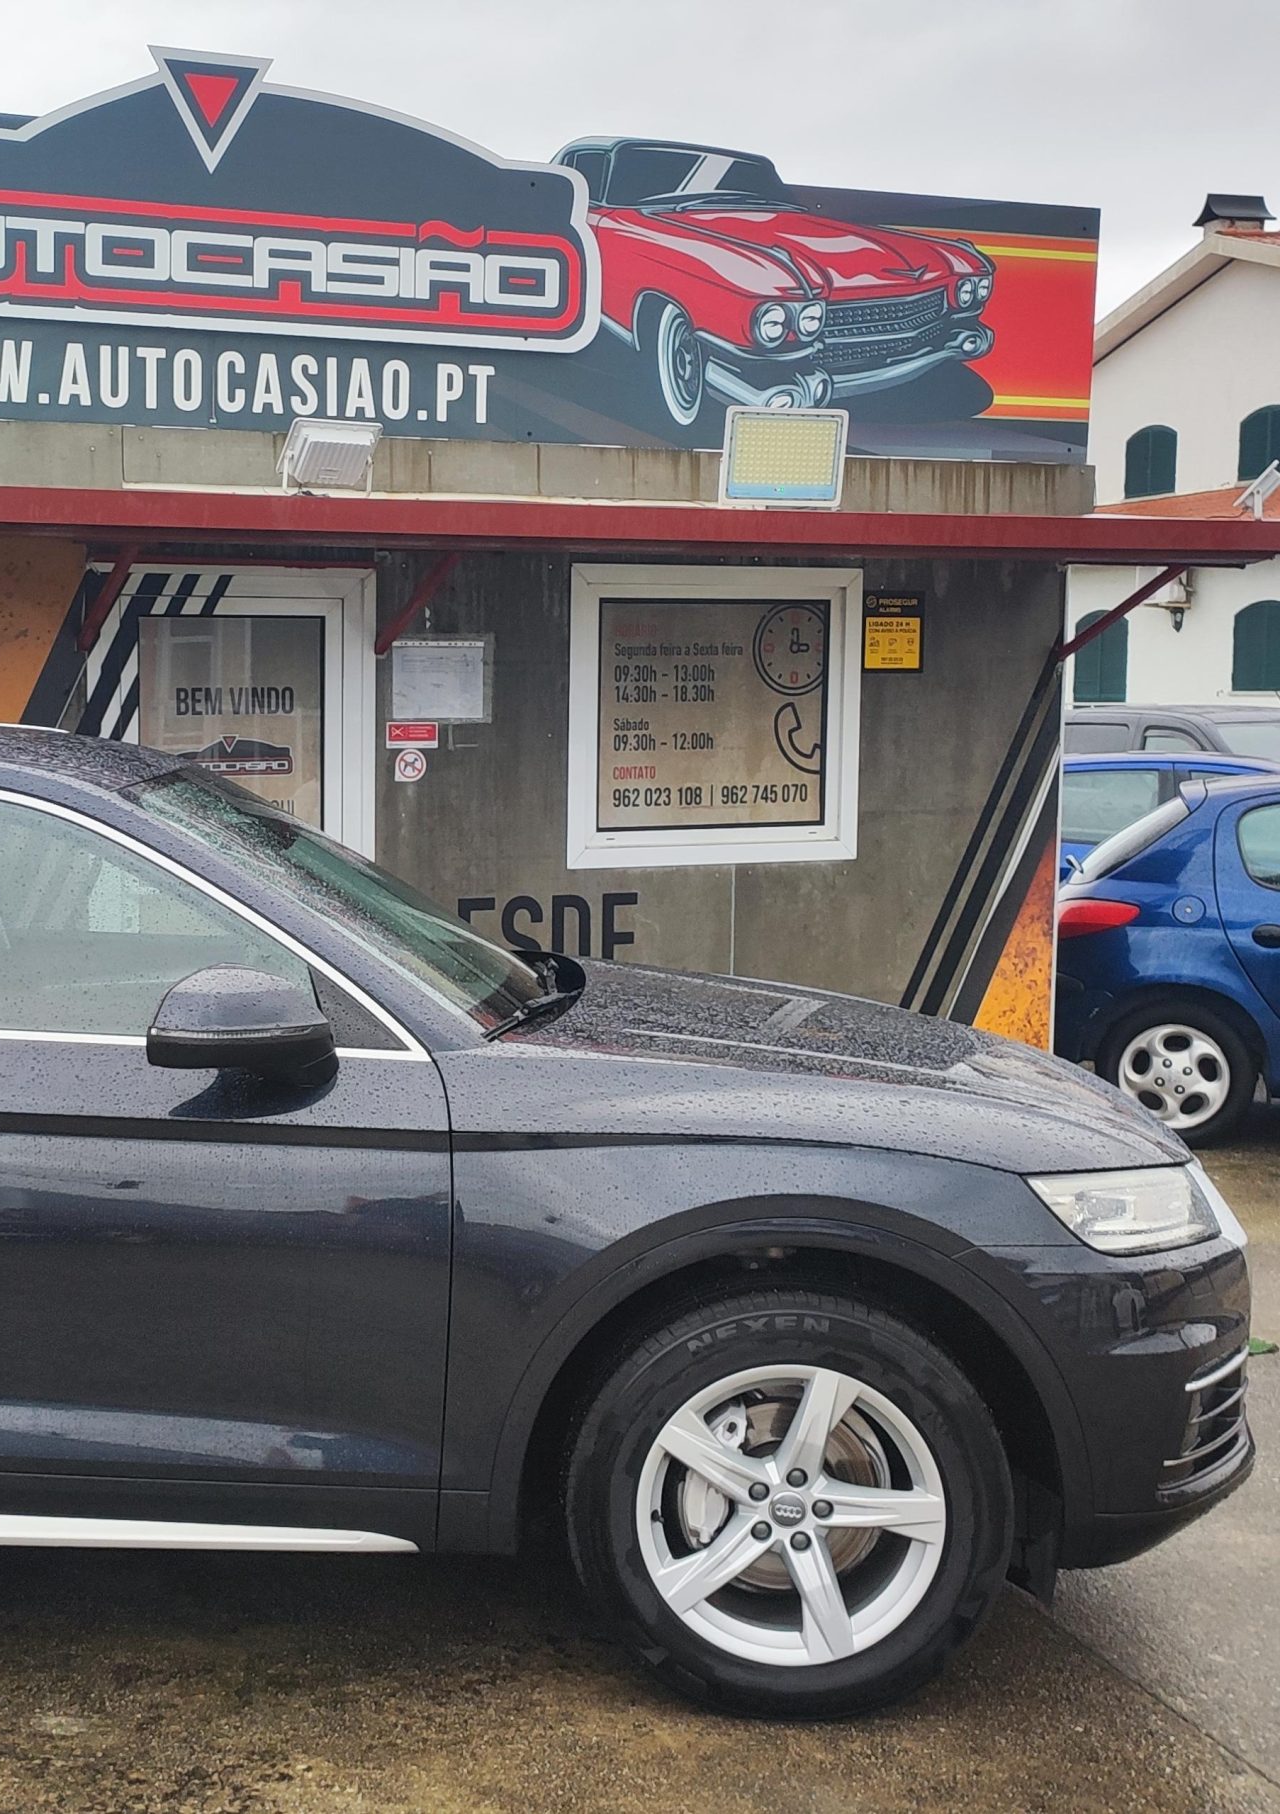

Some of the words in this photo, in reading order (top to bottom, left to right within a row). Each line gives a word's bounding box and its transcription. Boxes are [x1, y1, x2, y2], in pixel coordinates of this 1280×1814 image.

[614, 642, 657, 661] Segunda
[659, 643, 682, 657] feira
[684, 645, 691, 656] a
[693, 642, 719, 657] Sexta
[721, 642, 744, 656] feira
[614, 665, 657, 683] 09:30h
[673, 664, 715, 682] 13:00h
[175, 687, 223, 716] BEM
[229, 686, 294, 715] VINDO
[615, 685, 657, 703] 14:30h
[613, 718, 650, 732] Sábado
[613, 734, 656, 751] 09:30h
[673, 733, 714, 750] 12:00h
[613, 766, 656, 780] CONTATO
[613, 788, 640, 807] 962
[644, 787, 672, 806] 023
[677, 787, 702, 805] 108
[721, 786, 748, 804] 962
[752, 785, 778, 803] 745
[782, 783, 808, 802] 070
[686, 1315, 830, 1353] NEXEN
